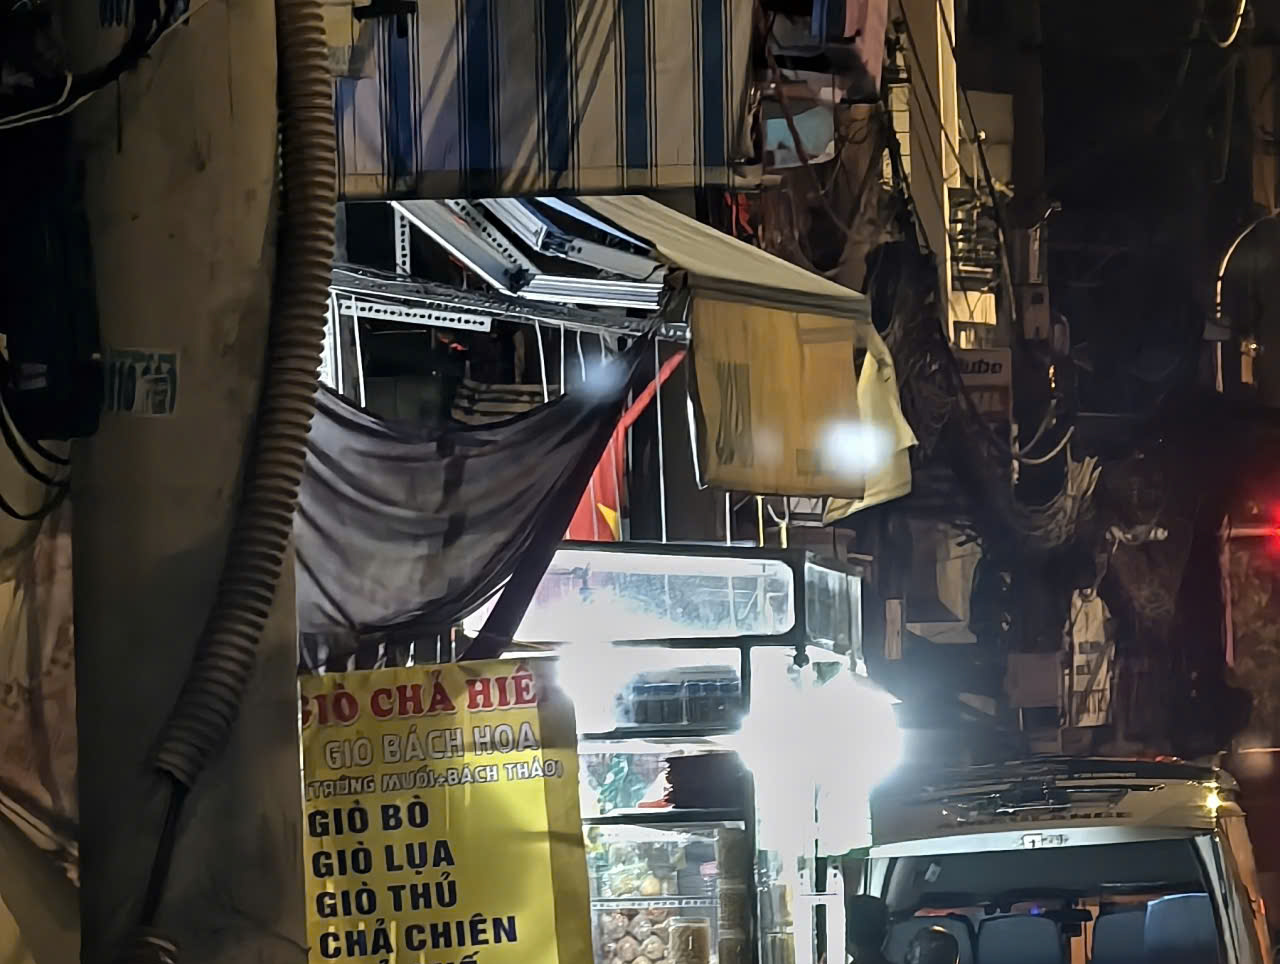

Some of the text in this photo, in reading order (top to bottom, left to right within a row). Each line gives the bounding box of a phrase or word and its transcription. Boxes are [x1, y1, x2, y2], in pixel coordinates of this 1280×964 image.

[382, 723, 465, 764] BÁCH
[308, 794, 429, 837] GIÒ BÒ
[312, 840, 455, 878] GIÒ LỤA
[316, 871, 457, 918] GIÒ THỦ
[320, 913, 517, 959] CHẢ CHIÊN
